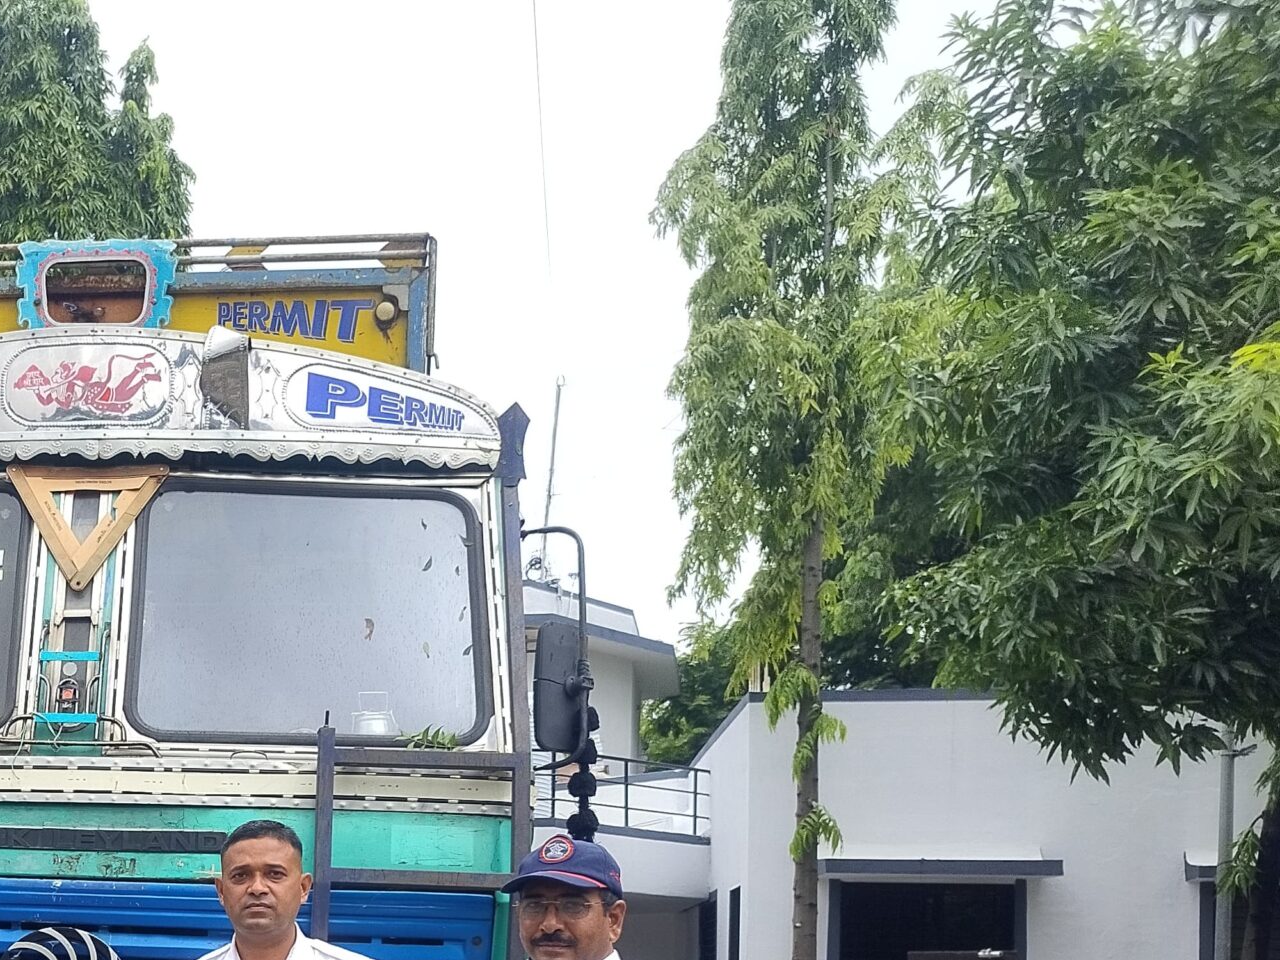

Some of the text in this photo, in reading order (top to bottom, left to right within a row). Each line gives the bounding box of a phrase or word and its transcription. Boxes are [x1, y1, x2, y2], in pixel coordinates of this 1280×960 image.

[218, 299, 376, 344] PERMIT
[305, 371, 466, 432] PERMIT
[51, 828, 223, 851] LEYLAND
